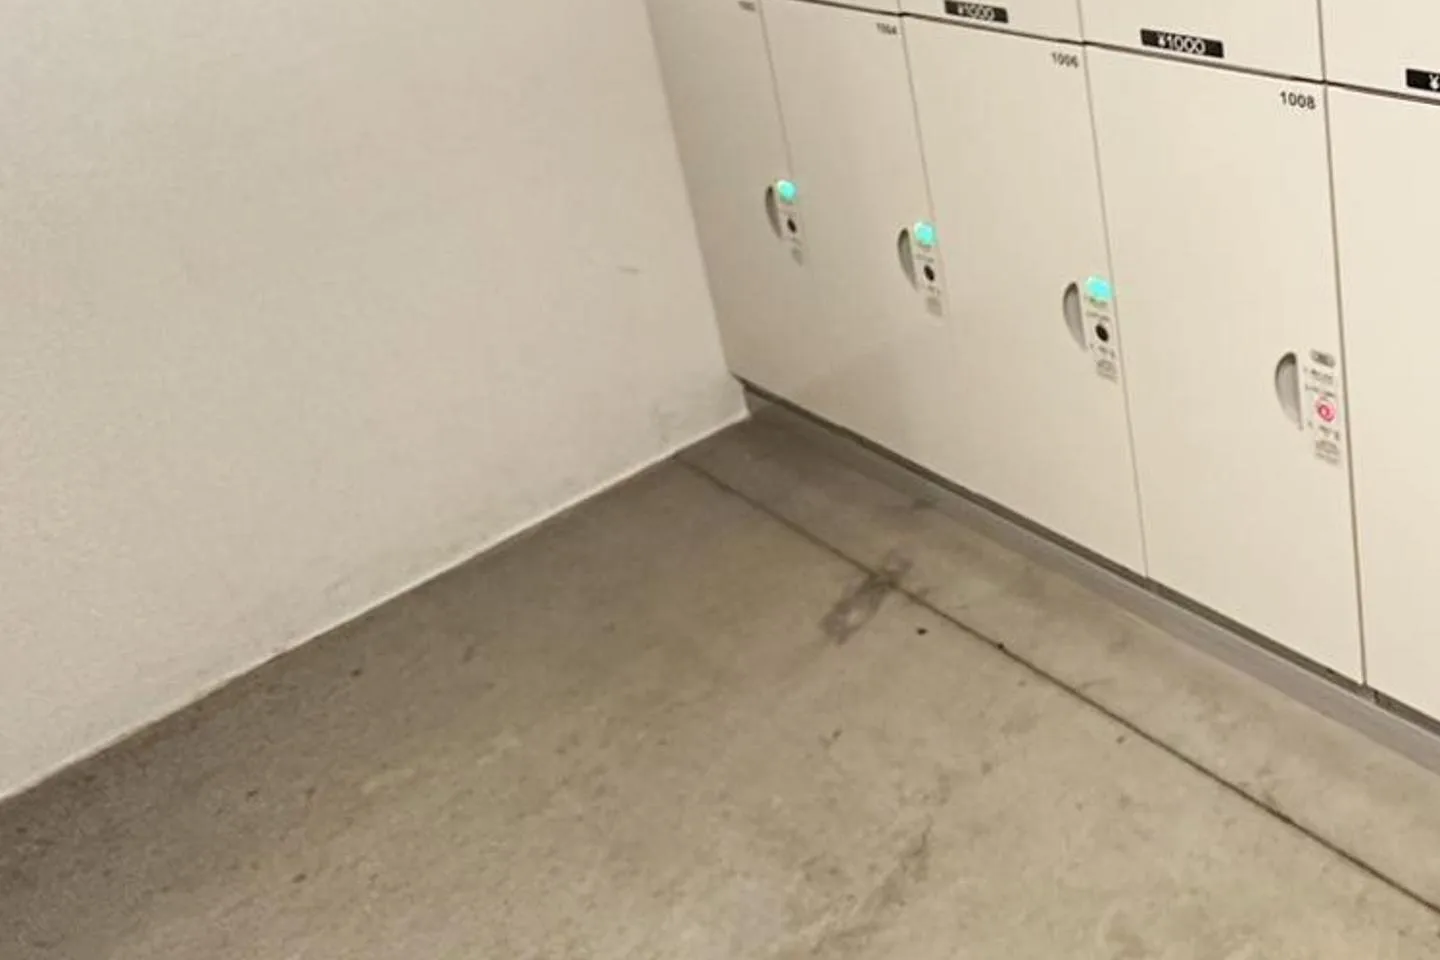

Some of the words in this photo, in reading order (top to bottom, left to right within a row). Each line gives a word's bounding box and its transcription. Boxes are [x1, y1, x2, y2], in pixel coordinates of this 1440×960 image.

[1156, 32, 1206, 55] ¥1000
[1051, 52, 1079, 68] 1006
[1279, 91, 1316, 111] 1008
